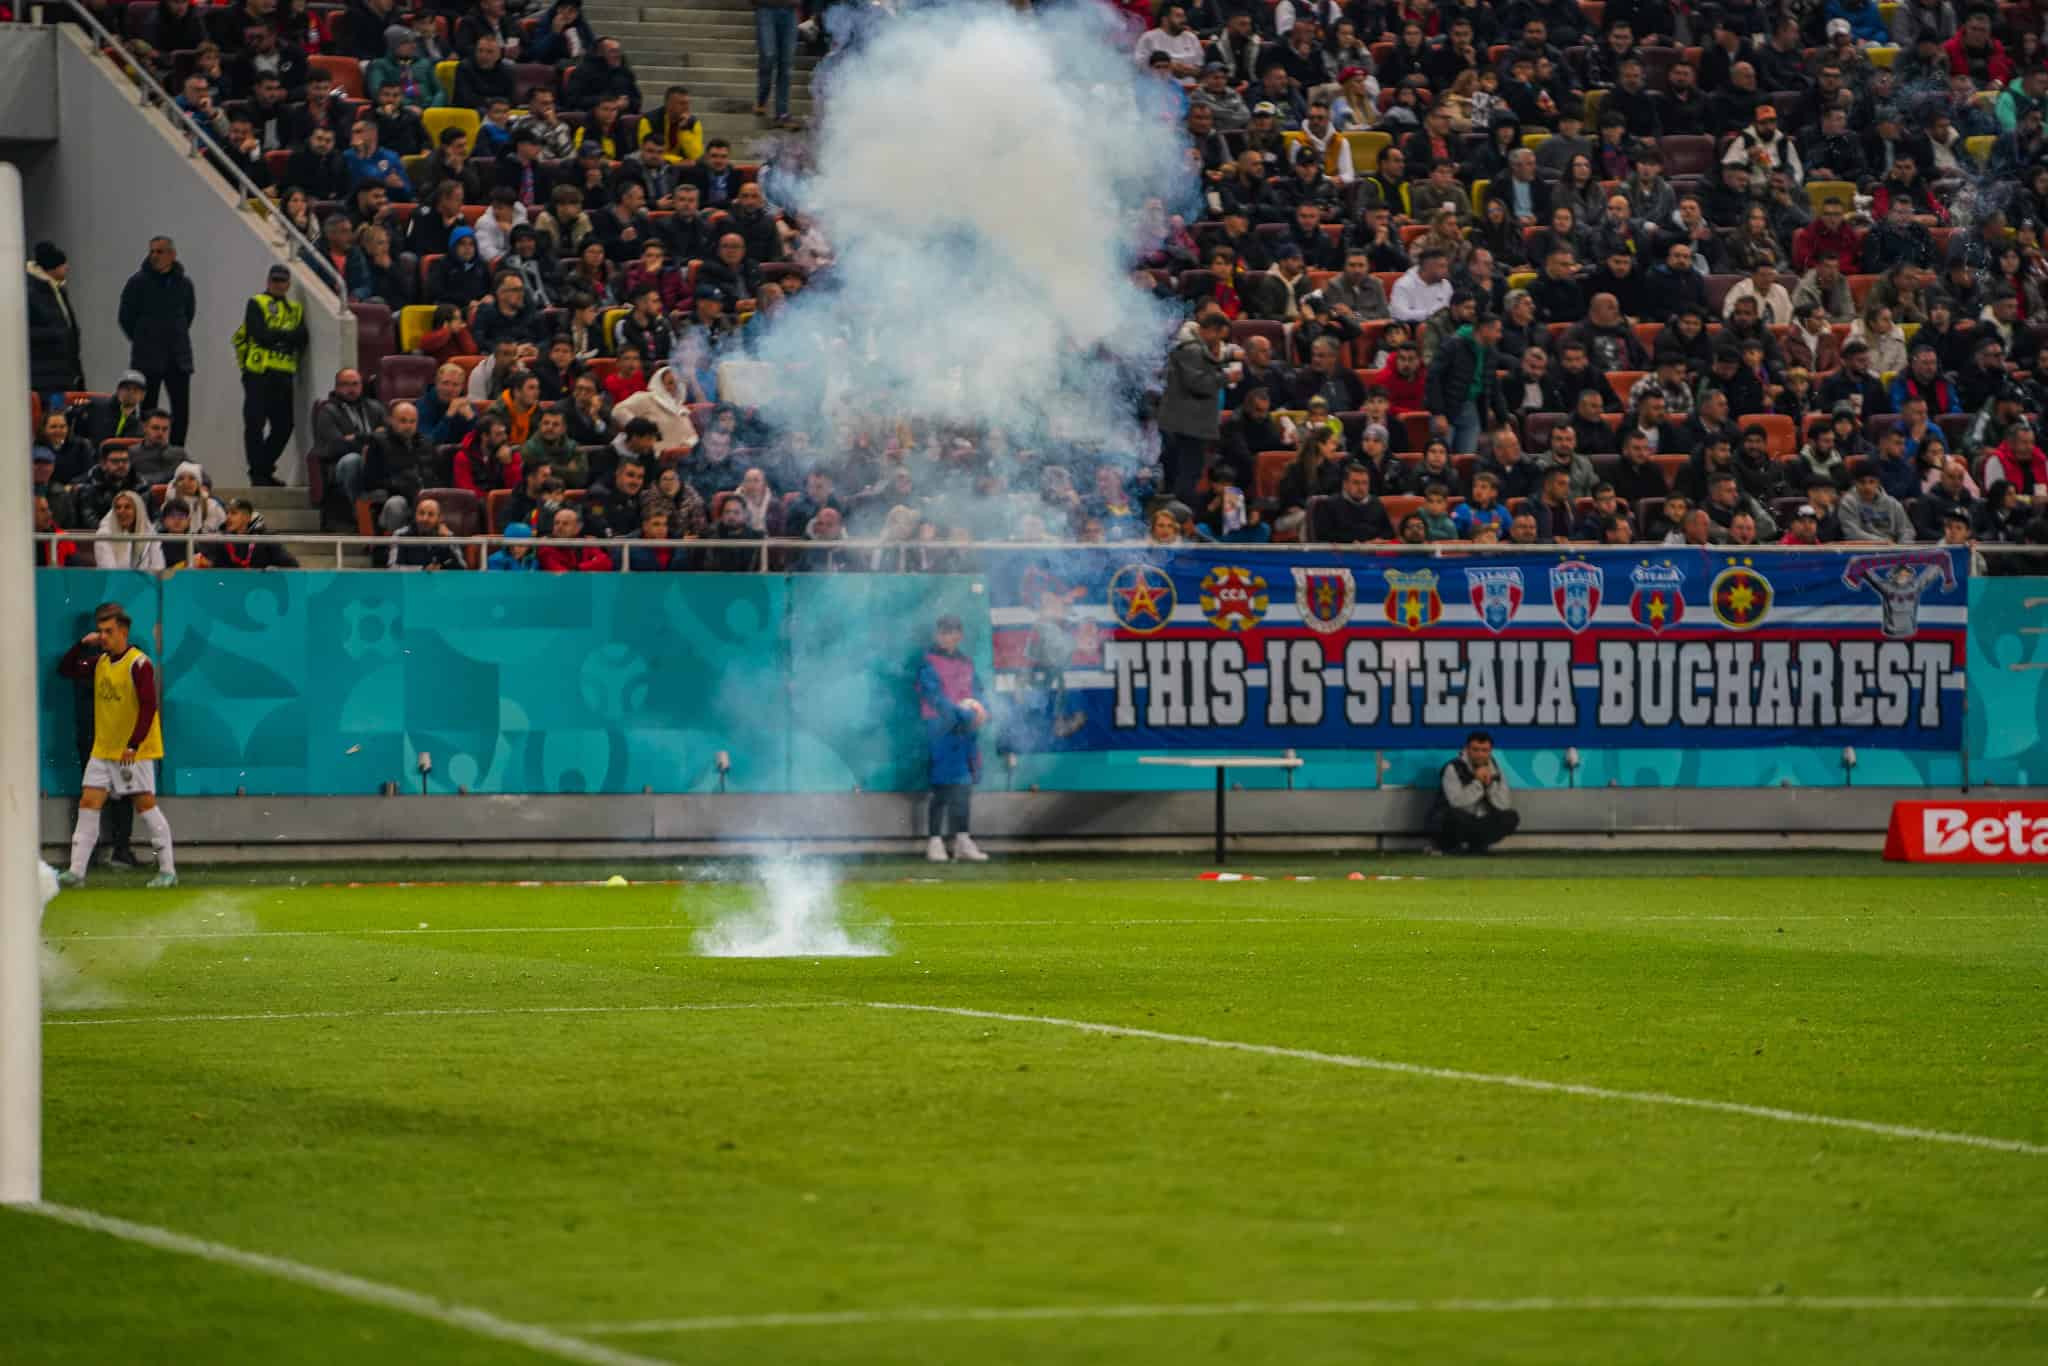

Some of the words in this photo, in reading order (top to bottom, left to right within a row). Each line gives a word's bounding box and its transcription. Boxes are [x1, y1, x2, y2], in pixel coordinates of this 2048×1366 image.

[1218, 587, 1249, 602] CCA
[1102, 640, 1246, 726] THIS
[1267, 640, 1323, 726] IS
[1345, 639, 1577, 725] STEAUA
[1598, 640, 1952, 727] BUCHAREST
